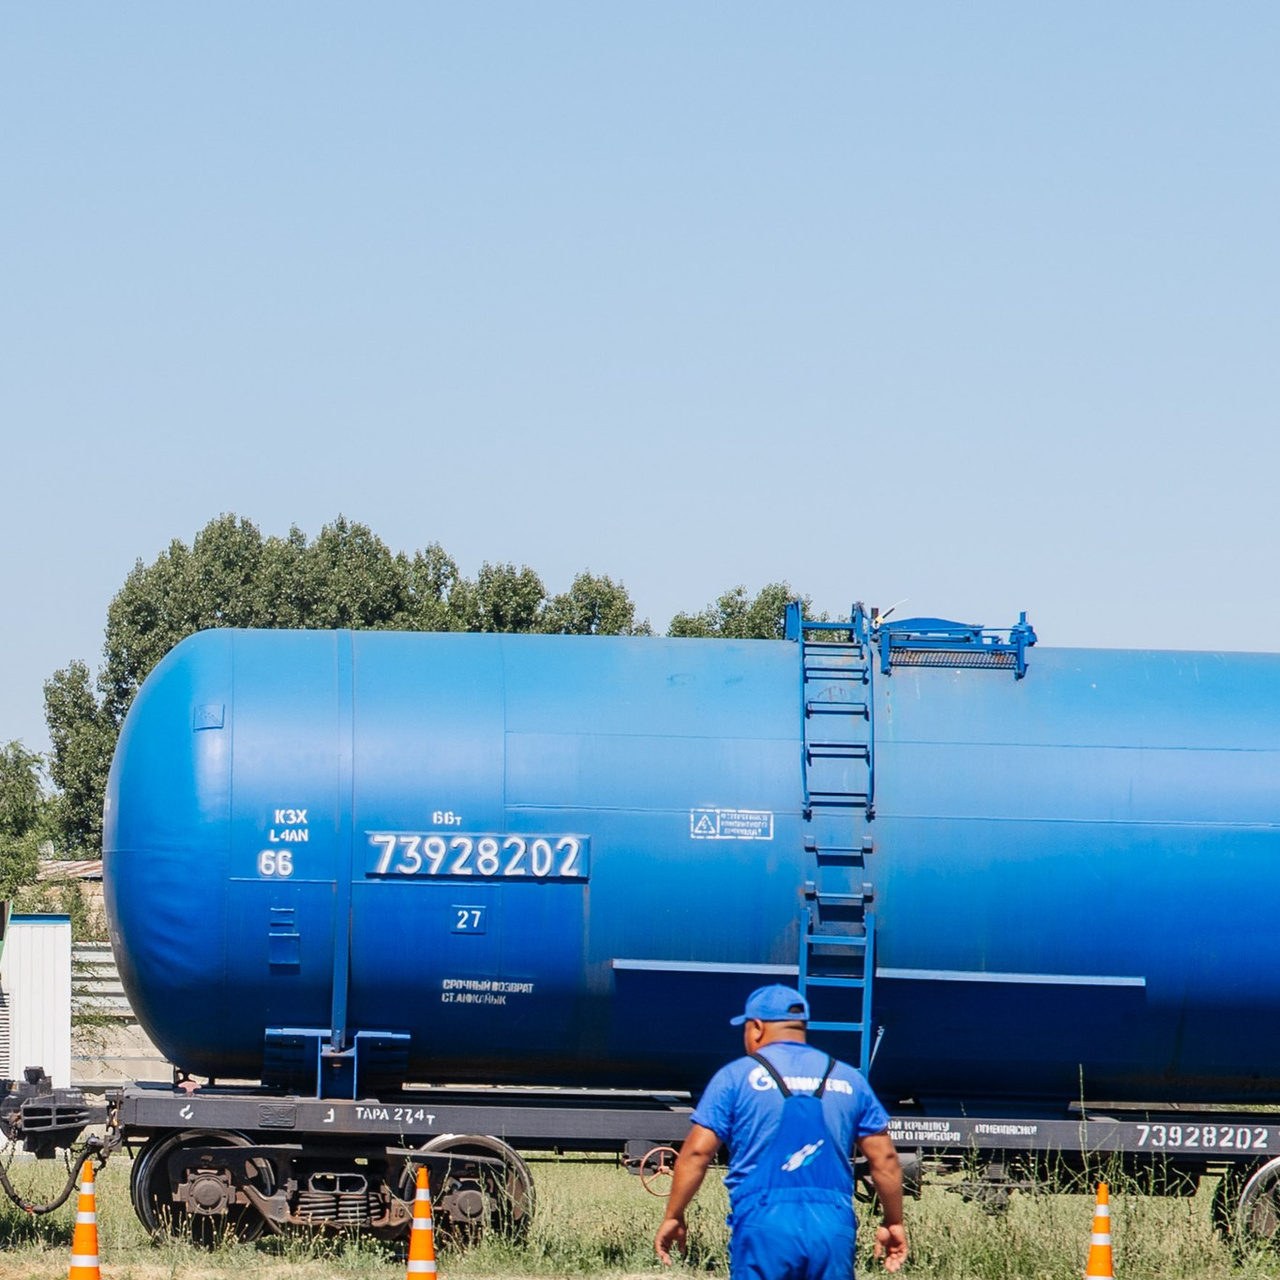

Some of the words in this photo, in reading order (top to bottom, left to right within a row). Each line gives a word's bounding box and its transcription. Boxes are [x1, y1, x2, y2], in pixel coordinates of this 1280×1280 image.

[260, 850, 293, 876] 66
[372, 835, 580, 877] 73928202
[456, 910, 481, 929] 27
[1136, 1124, 1269, 1149] 73928202
